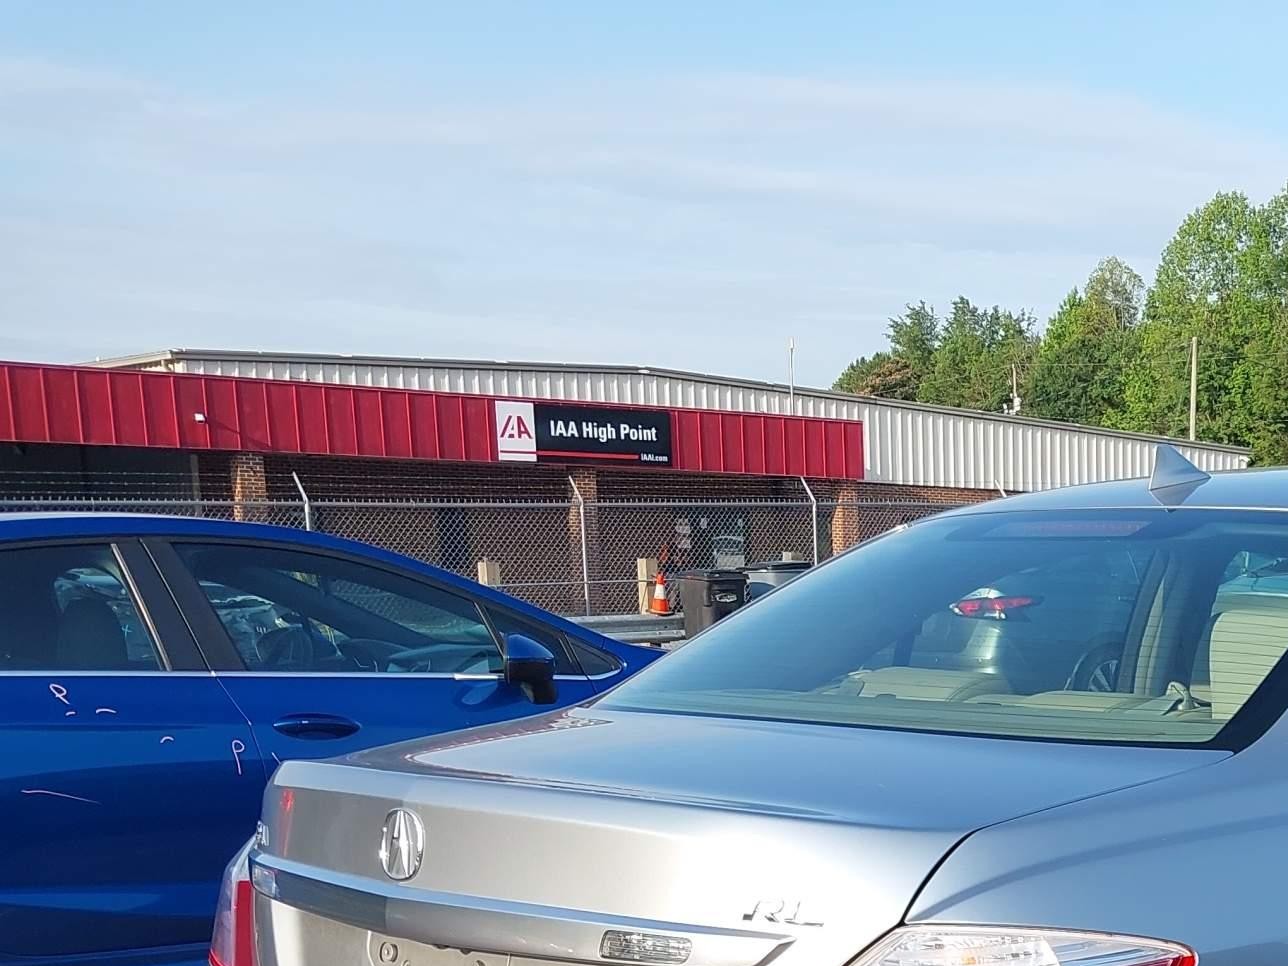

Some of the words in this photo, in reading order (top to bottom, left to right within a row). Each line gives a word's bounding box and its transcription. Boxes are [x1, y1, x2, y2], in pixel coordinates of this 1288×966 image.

[549, 419, 579, 438] IAA
[582, 420, 617, 443] High
[620, 424, 658, 442] Point
[742, 898, 825, 927] RL
